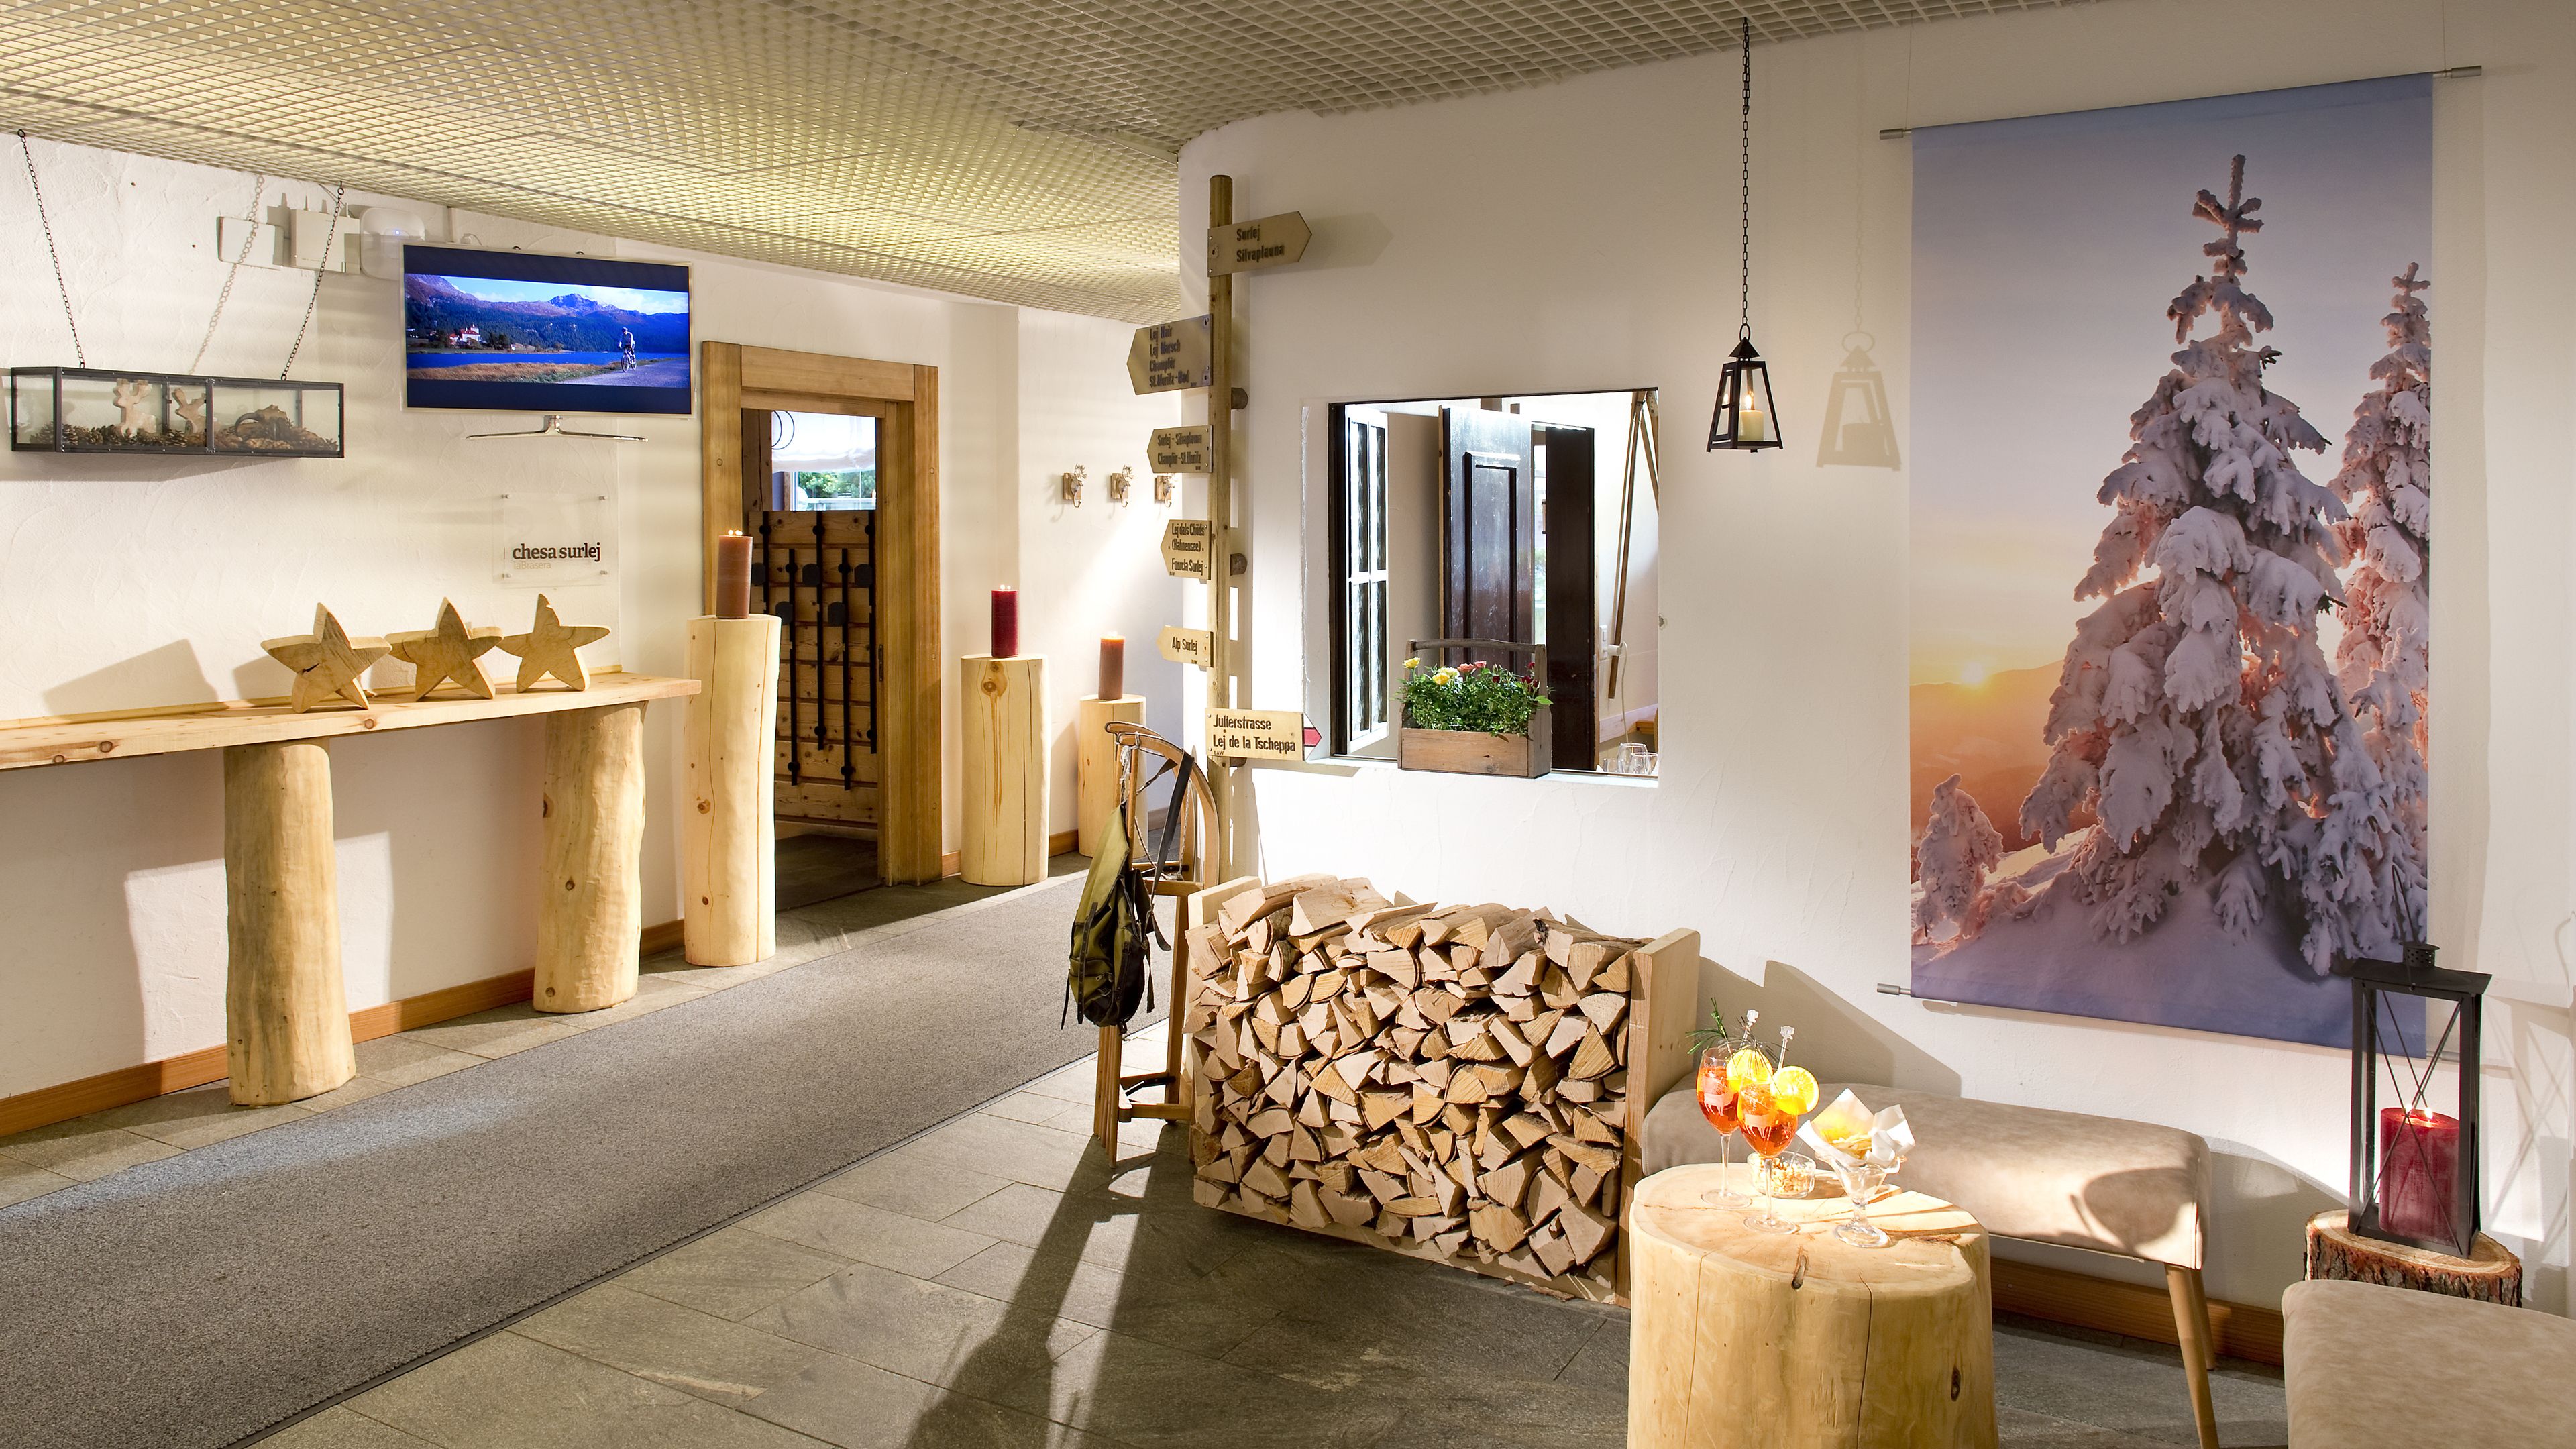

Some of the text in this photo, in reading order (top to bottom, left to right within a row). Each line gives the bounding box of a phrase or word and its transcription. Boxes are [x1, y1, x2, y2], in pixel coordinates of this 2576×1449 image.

[1236, 225, 1260, 242] Surlej
[1236, 245, 1285, 262] Silvaplauna
[513, 542, 600, 562] chesa surlej
[1189, 559, 1203, 576] Surlej
[1172, 637, 1197, 655] Alp Surlej
[1213, 714, 1271, 730] Julierstrasse
[1213, 734, 1295, 754] Lej de la Tscheppa
